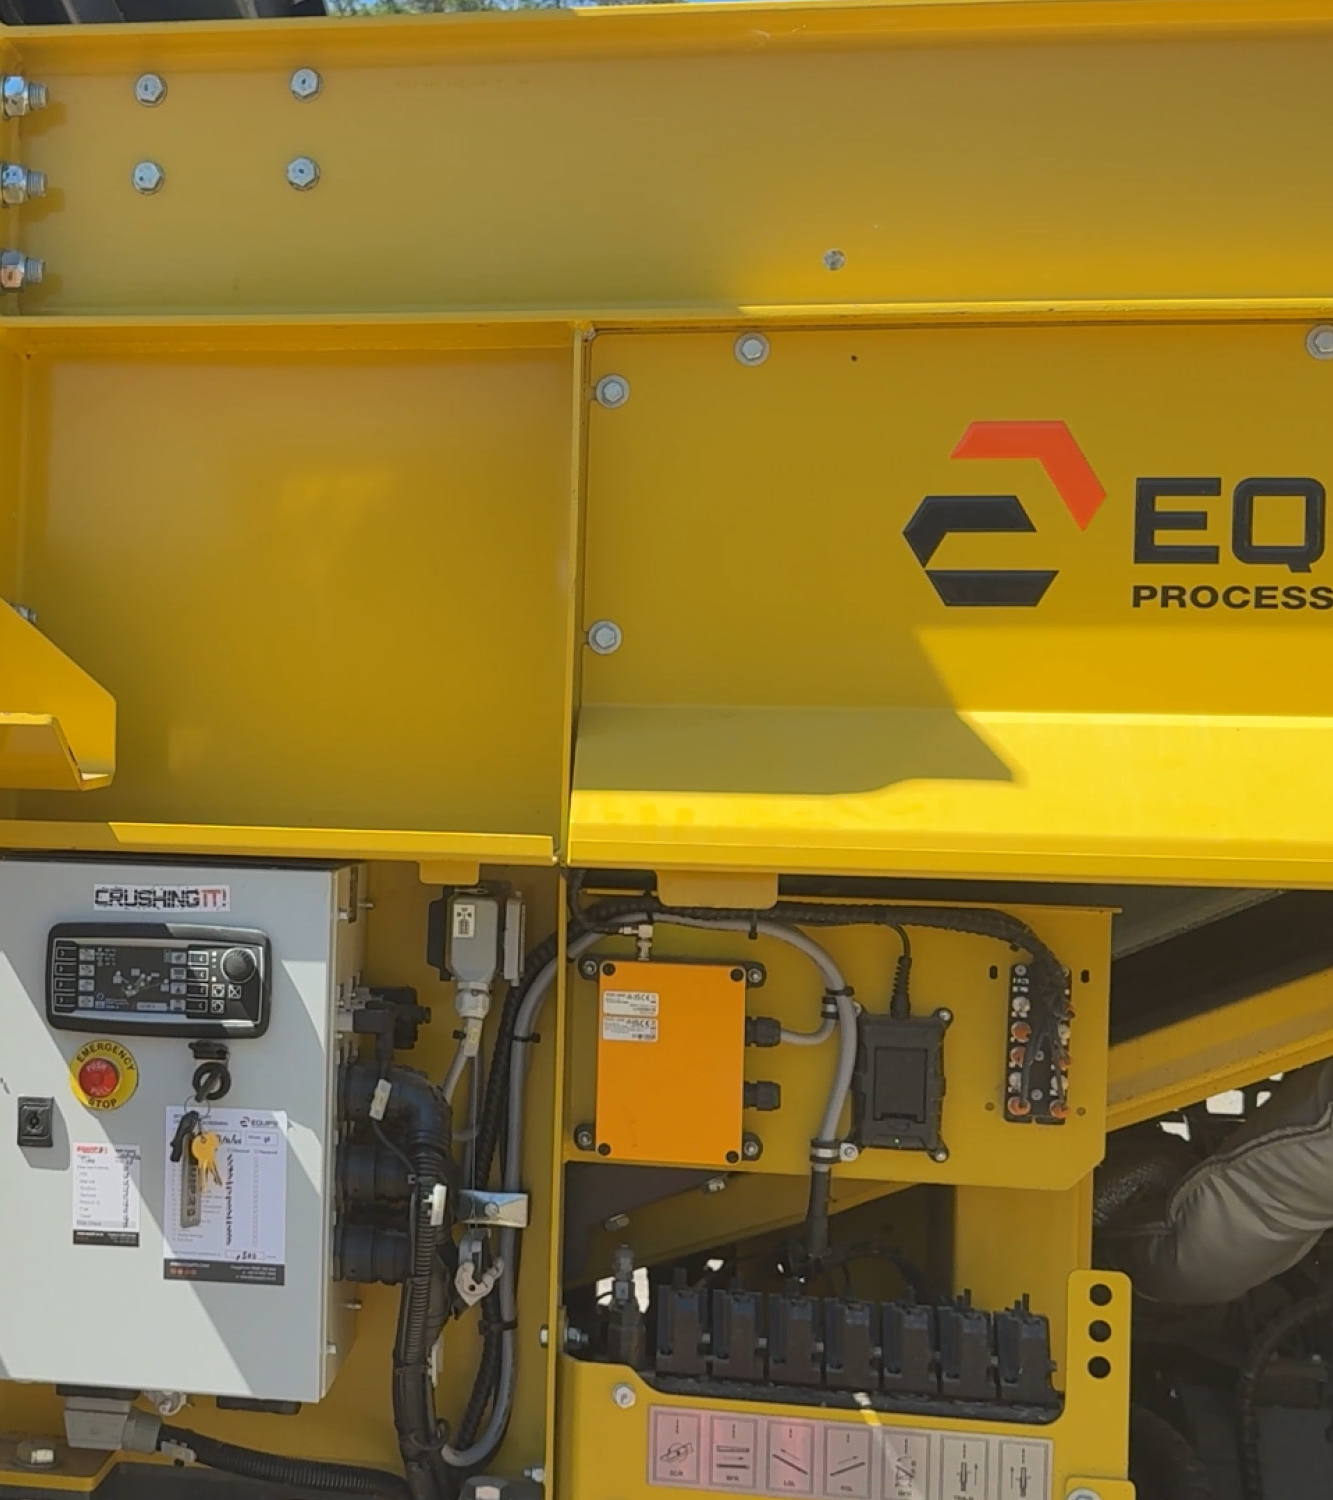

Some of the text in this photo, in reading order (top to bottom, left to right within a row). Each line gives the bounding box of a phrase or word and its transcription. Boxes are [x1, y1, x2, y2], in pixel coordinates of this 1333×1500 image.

[1134, 477, 1326, 573] EQ
[1133, 584, 1333, 609] PROCESS
[76, 1042, 136, 1071] EMERGENCY
[87, 1097, 117, 1109] STOP
